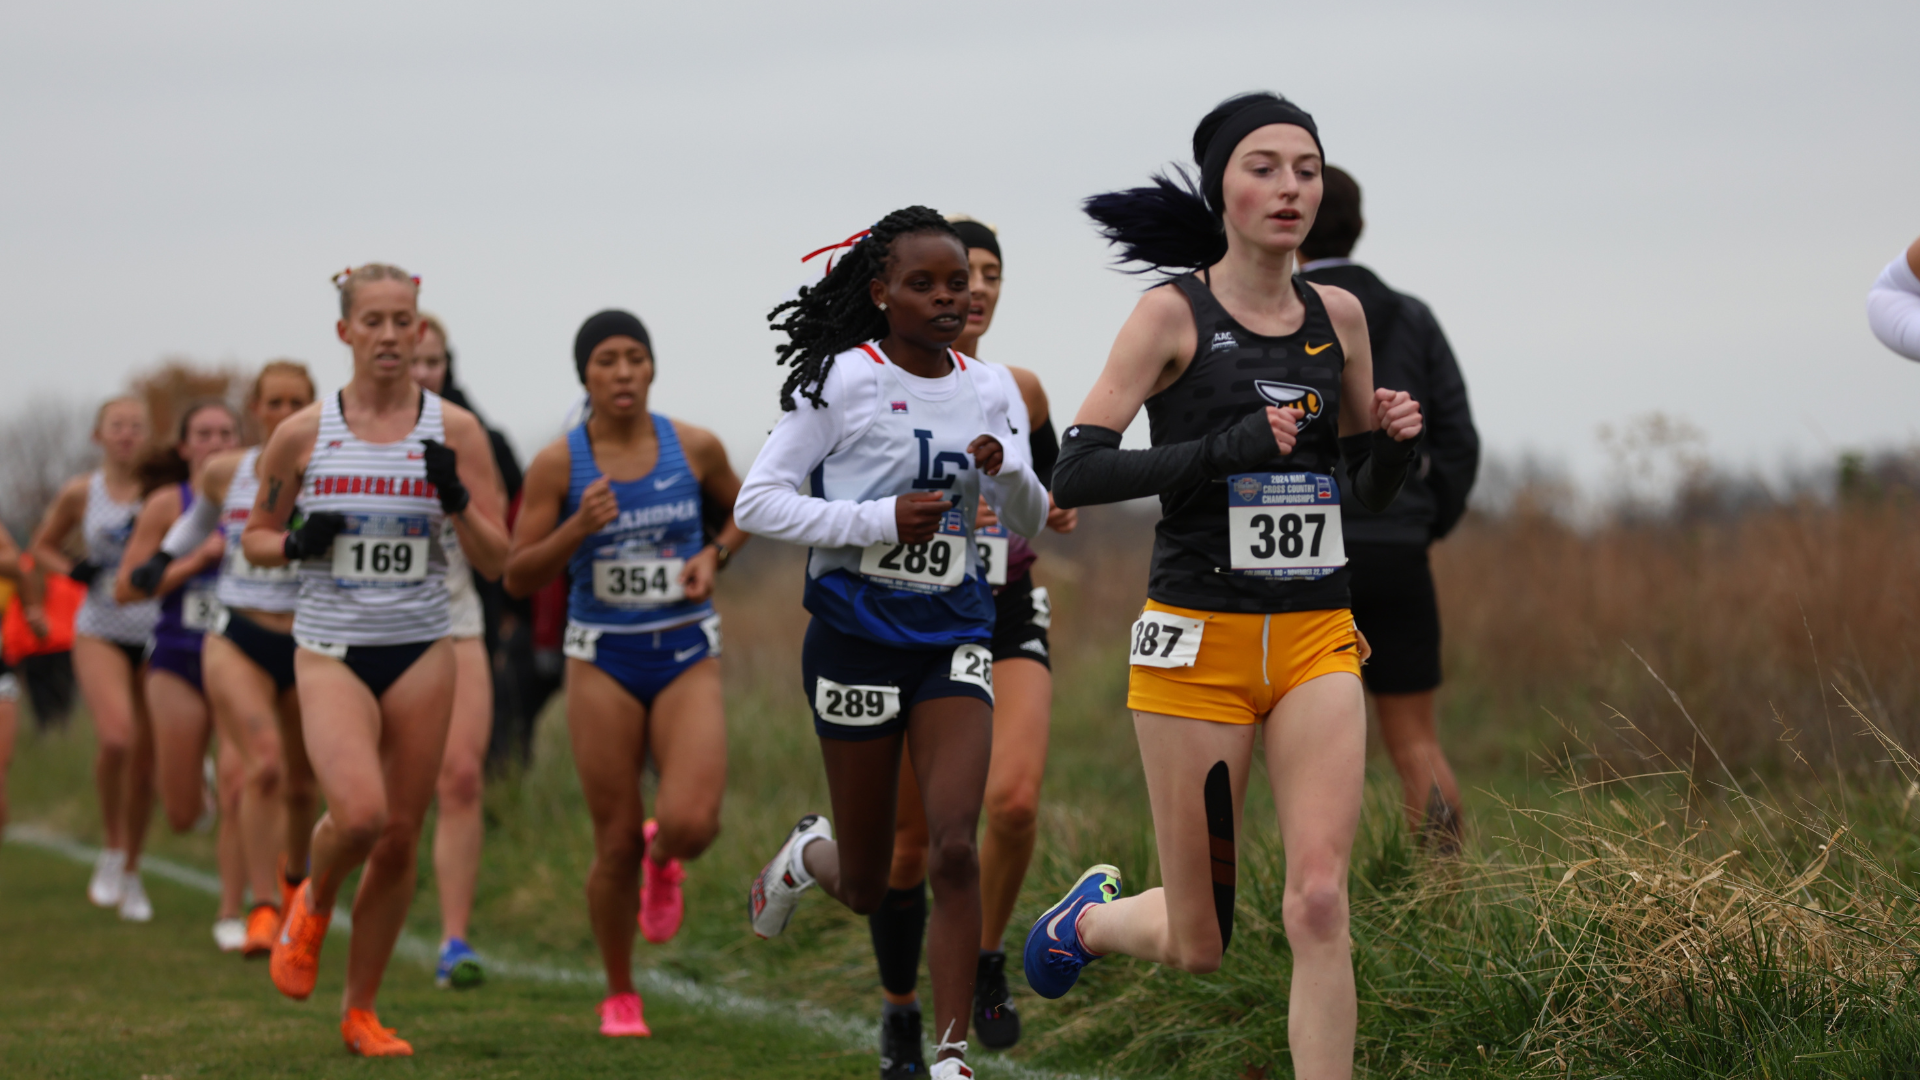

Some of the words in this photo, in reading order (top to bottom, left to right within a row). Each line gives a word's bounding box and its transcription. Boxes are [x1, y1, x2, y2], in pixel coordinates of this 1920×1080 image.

[1262, 485, 1286, 494] CROSS
[1287, 484, 1315, 494] COUNTRY
[1271, 475, 1289, 484] 2024
[1290, 474, 1306, 483] NAIA
[1262, 494, 1315, 504] CHAMPIONSHIPS
[1250, 513, 1326, 560] 387
[350, 541, 412, 574] 169
[878, 541, 951, 577] 289
[608, 567, 669, 596] 354
[1132, 620, 1184, 658] 387
[825, 689, 885, 718] 289
